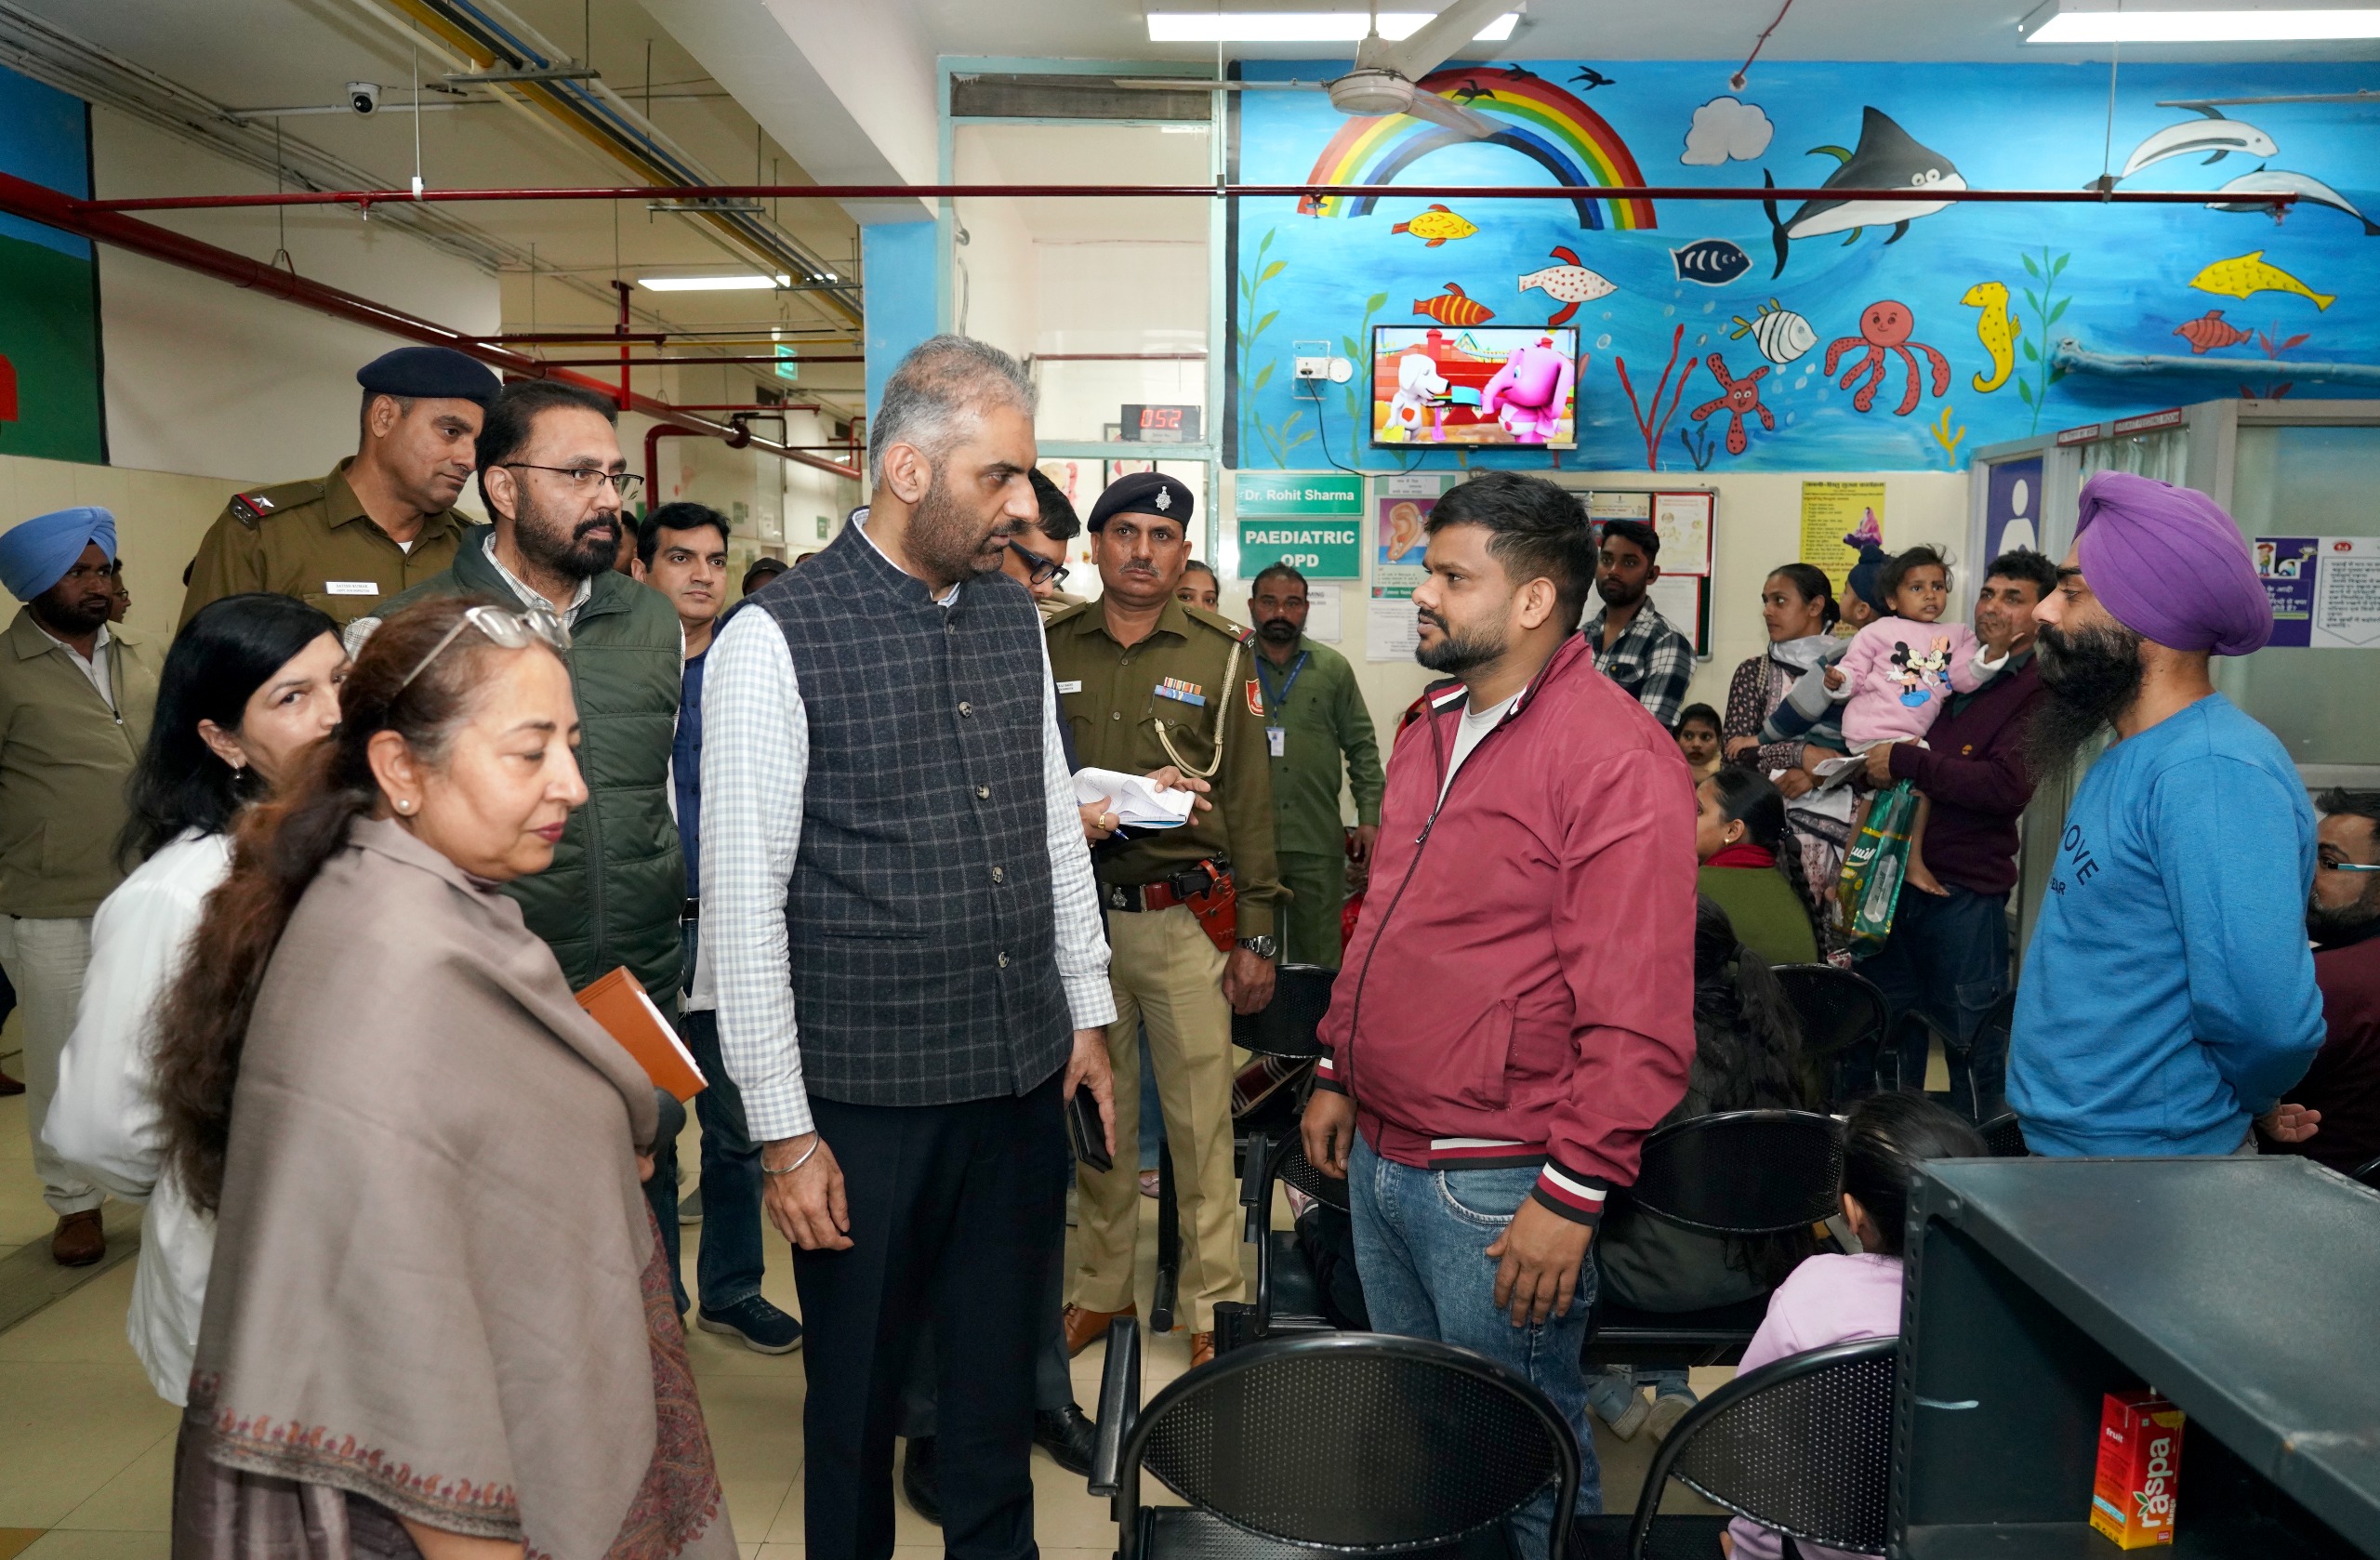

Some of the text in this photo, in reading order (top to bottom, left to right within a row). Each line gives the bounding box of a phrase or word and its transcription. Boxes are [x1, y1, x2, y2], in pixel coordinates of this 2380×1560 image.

[1140, 408, 1183, 429] 052
[1245, 489, 1355, 501] Dr. Rohit Sharma
[1245, 530, 1355, 545] PAEDIATRIC
[1280, 553, 1320, 568] OPD
[2061, 818, 2100, 886] OVE
[2105, 1427, 2124, 1444] fruit
[2142, 1437, 2174, 1527] raspa
